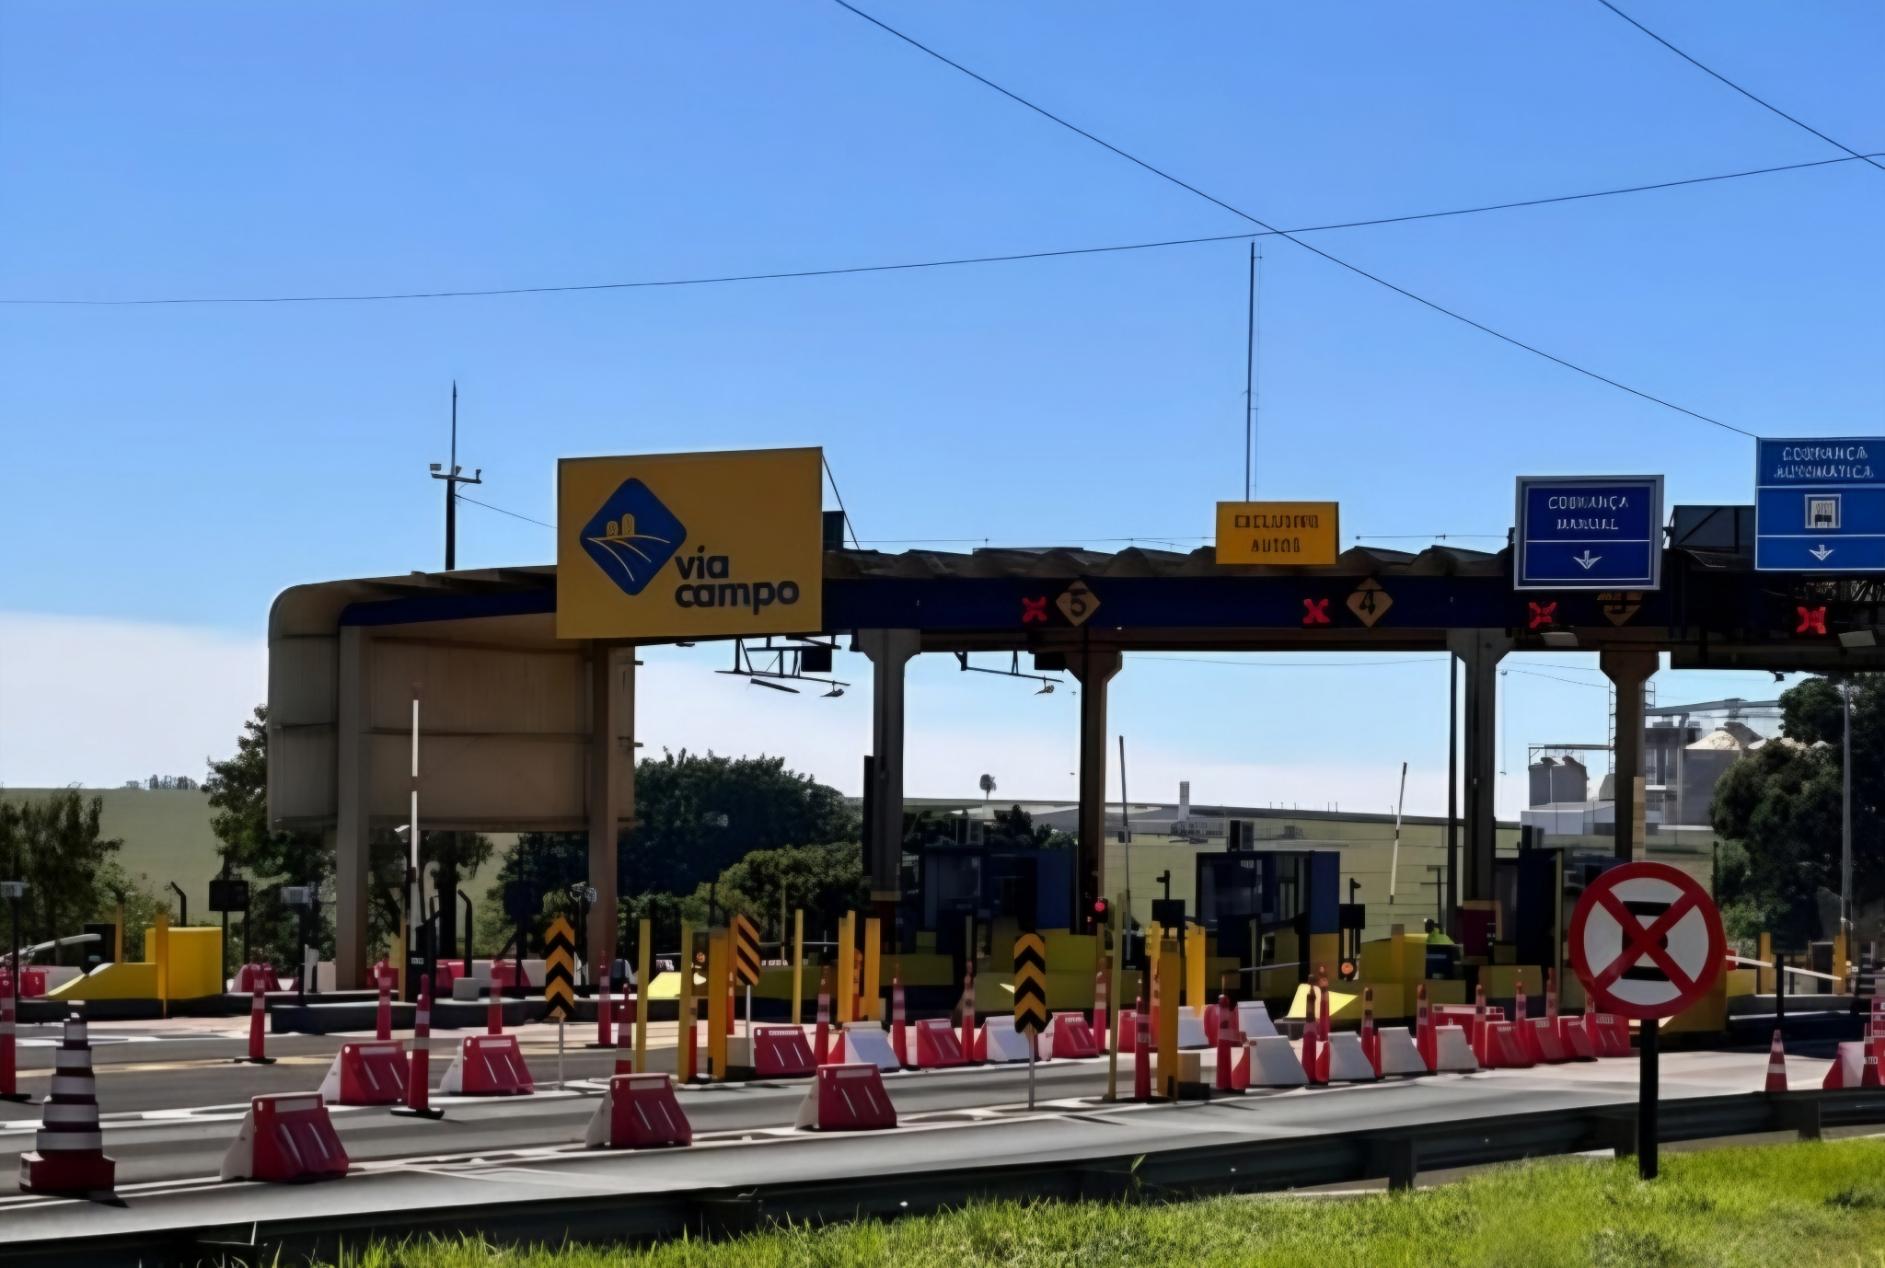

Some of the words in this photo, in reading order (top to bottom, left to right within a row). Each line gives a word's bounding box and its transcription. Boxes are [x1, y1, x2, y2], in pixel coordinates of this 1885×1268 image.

[675, 545, 729, 580] via
[675, 581, 800, 616] campo
[1359, 588, 1376, 615] 4
